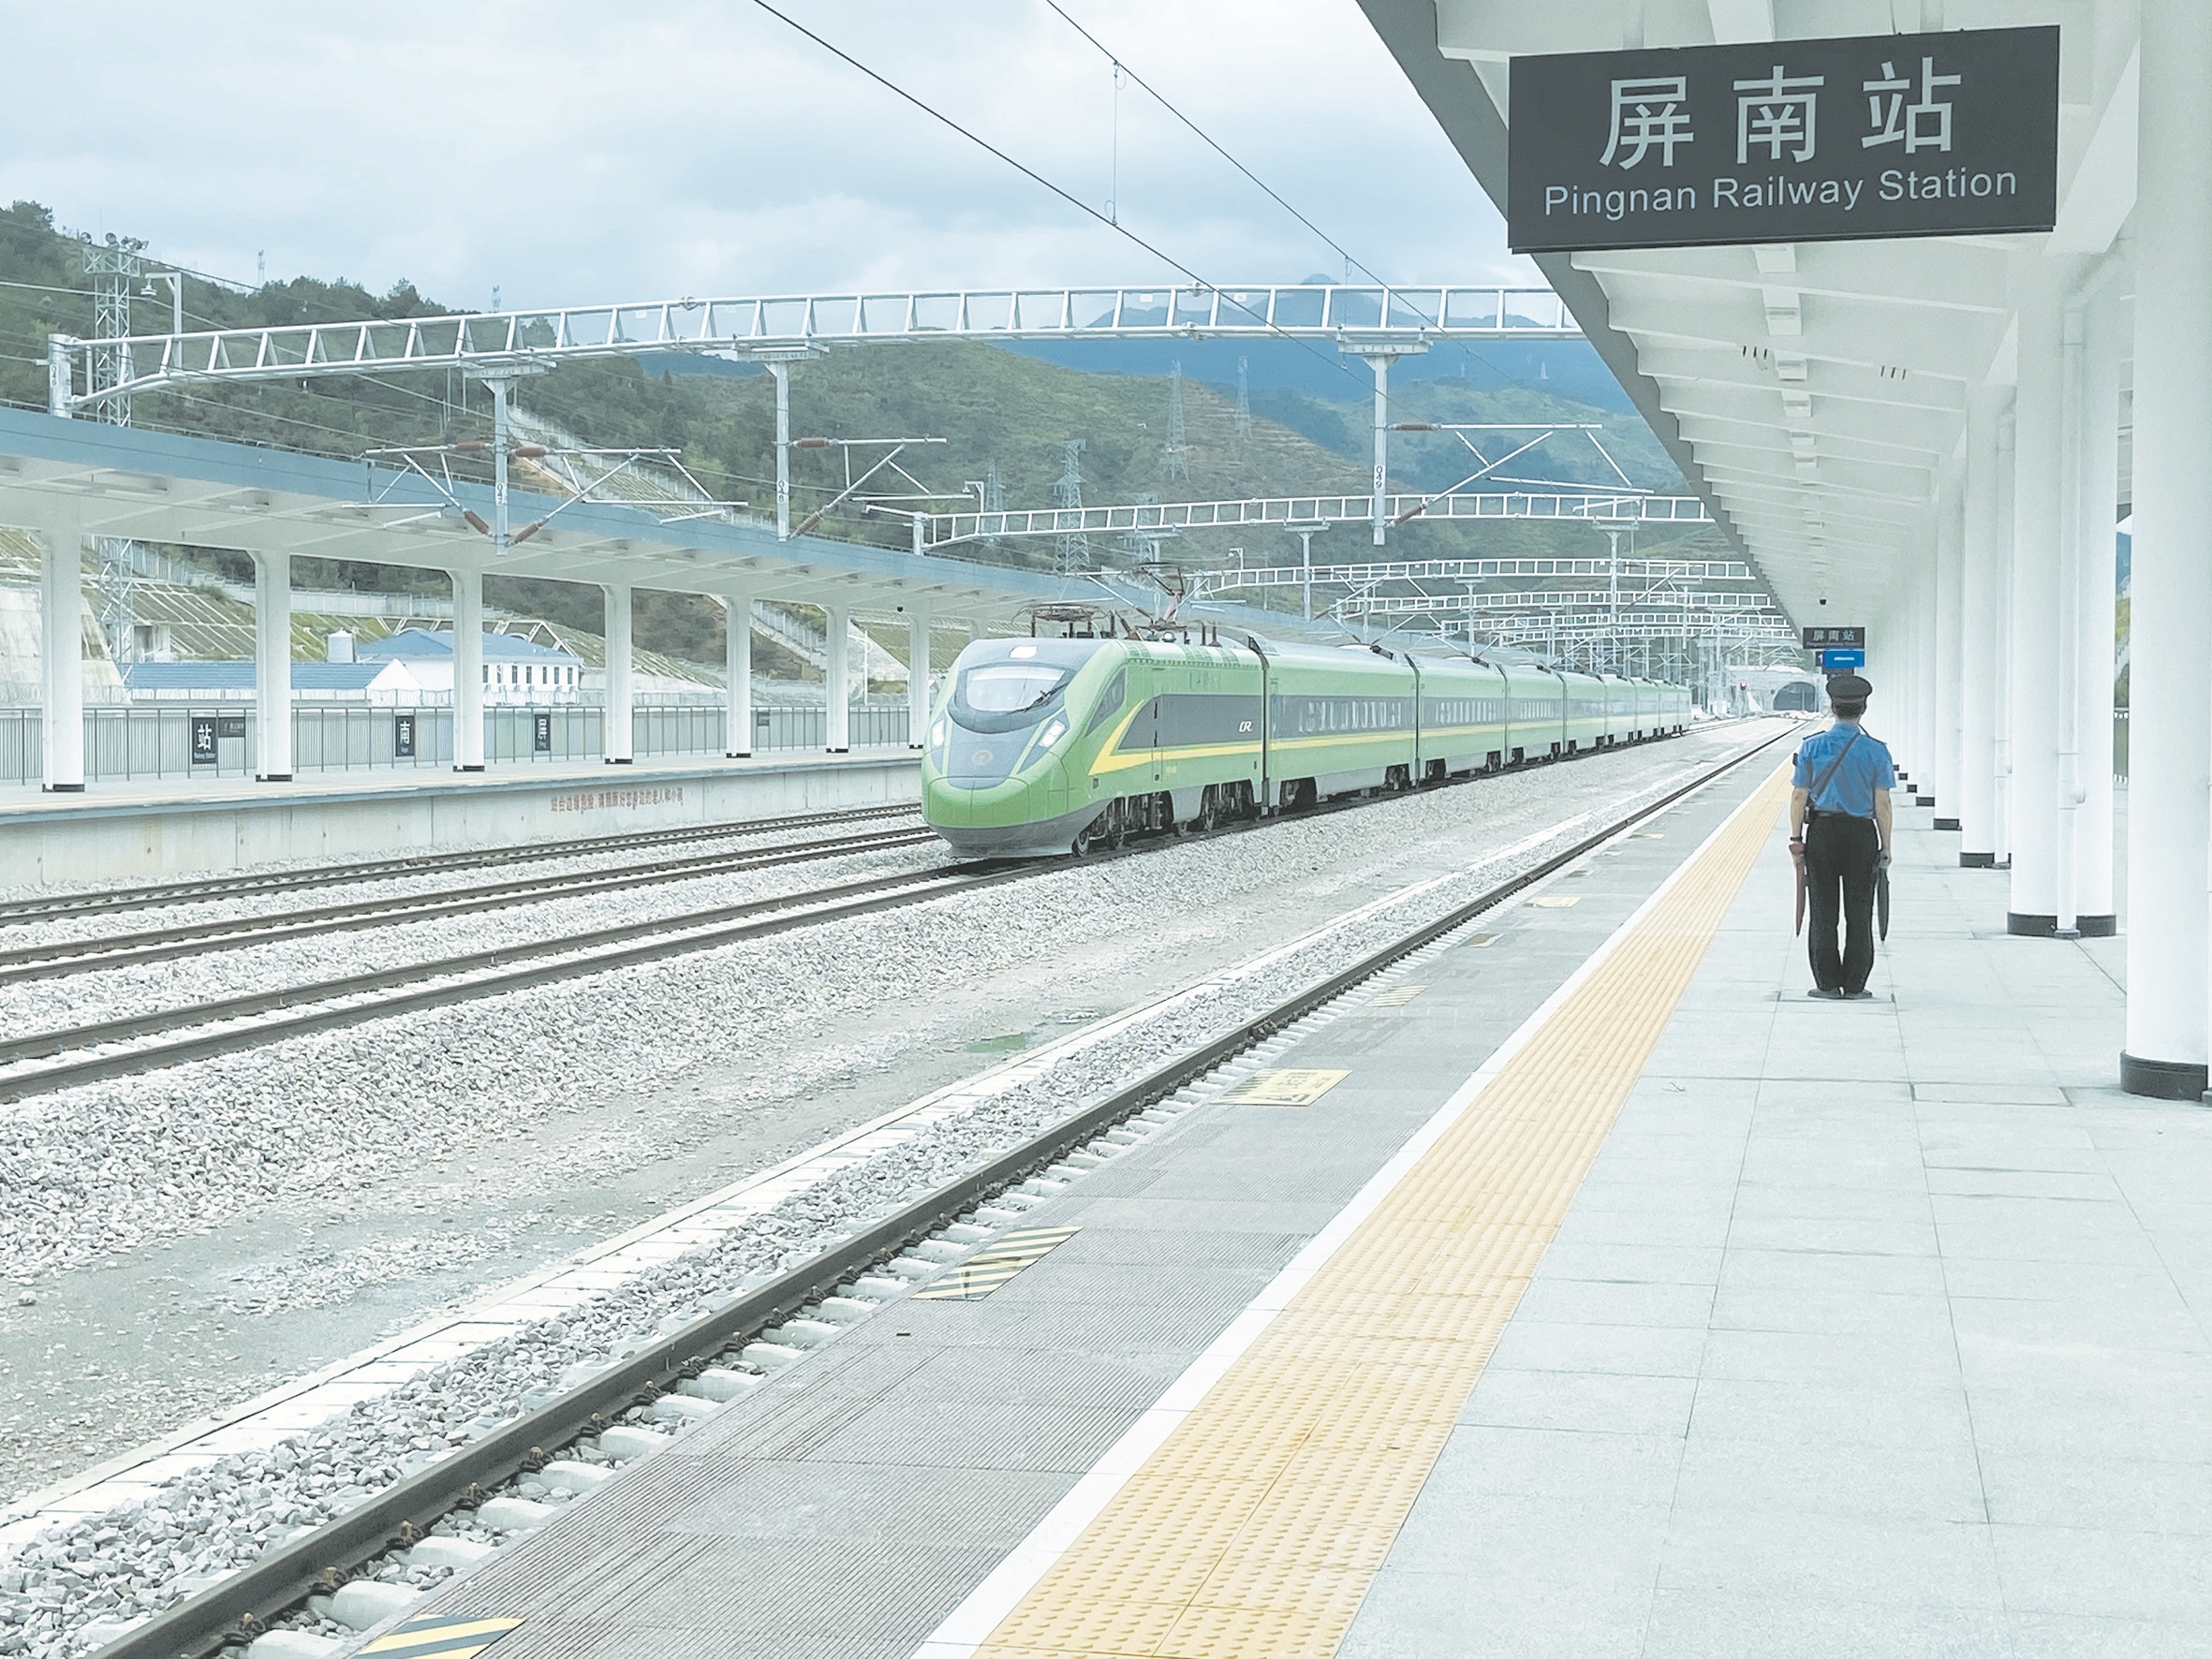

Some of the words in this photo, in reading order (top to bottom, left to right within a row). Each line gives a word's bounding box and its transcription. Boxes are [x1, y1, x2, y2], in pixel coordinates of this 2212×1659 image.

[1599, 56, 1963, 171] 屏南站
[1545, 185, 1697, 222] Pingnan
[1713, 174, 1865, 212] Railway
[1879, 167, 2017, 202] Station
[197, 723, 214, 751] 站
